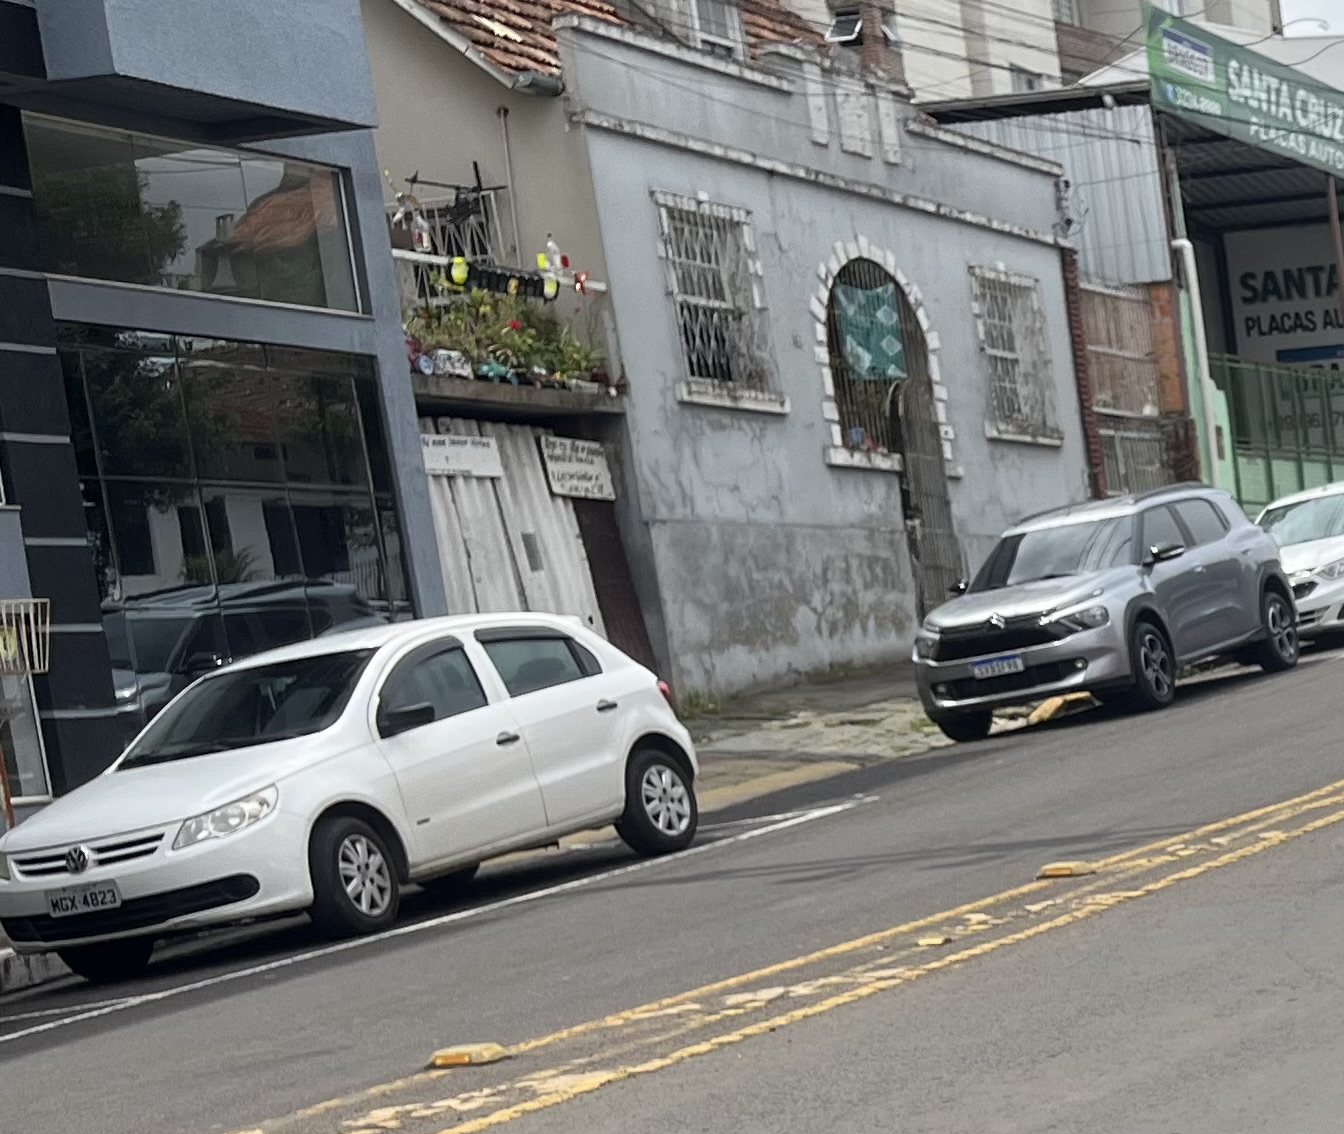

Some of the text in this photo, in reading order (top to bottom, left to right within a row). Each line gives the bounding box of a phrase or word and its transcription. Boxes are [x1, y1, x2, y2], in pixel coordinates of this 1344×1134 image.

[1227, 59, 1293, 123] SANTA
[1249, 116, 1306, 155] PLACAS
[1245, 309, 1317, 337] PLACAS
